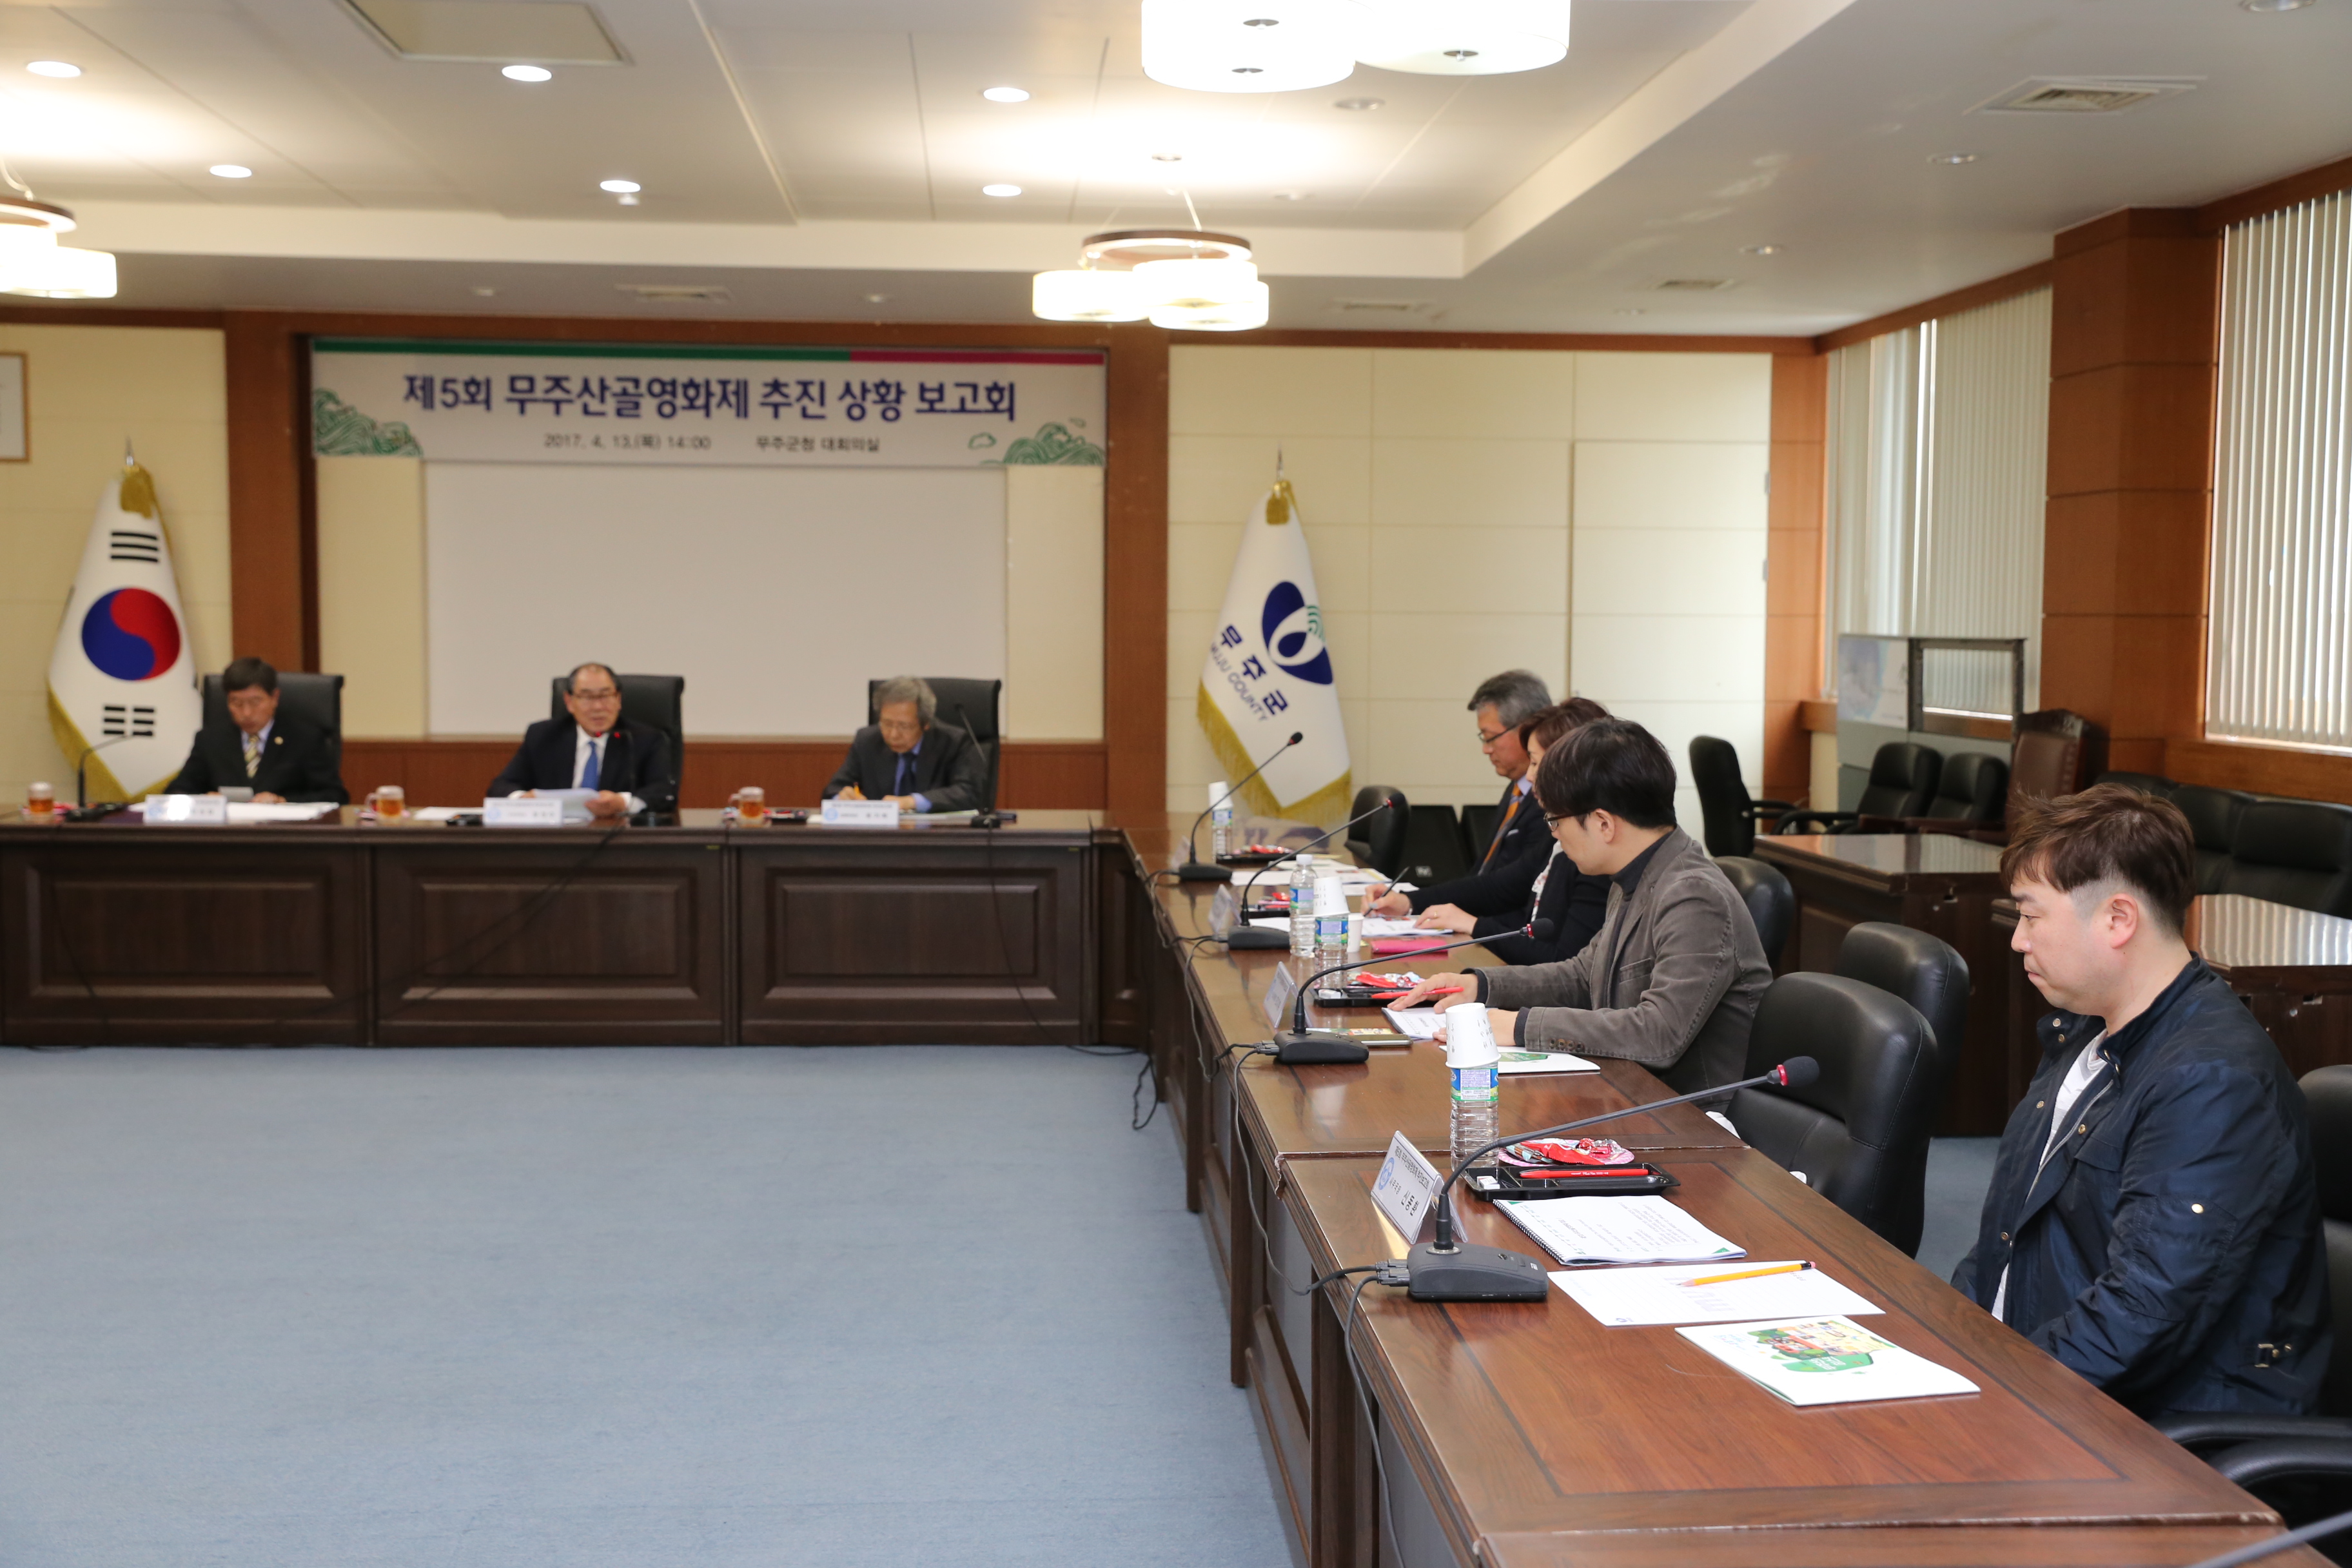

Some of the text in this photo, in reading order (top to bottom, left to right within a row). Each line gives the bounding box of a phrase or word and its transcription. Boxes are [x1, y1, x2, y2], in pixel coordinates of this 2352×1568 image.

[404, 375, 1015, 422] 제5회 무주산골영화제 추진 상황 보고회
[1222, 625, 1288, 715] 무주군
[1228, 672, 1268, 721] COUNTY
[1400, 1190, 1420, 1217] 신동환
